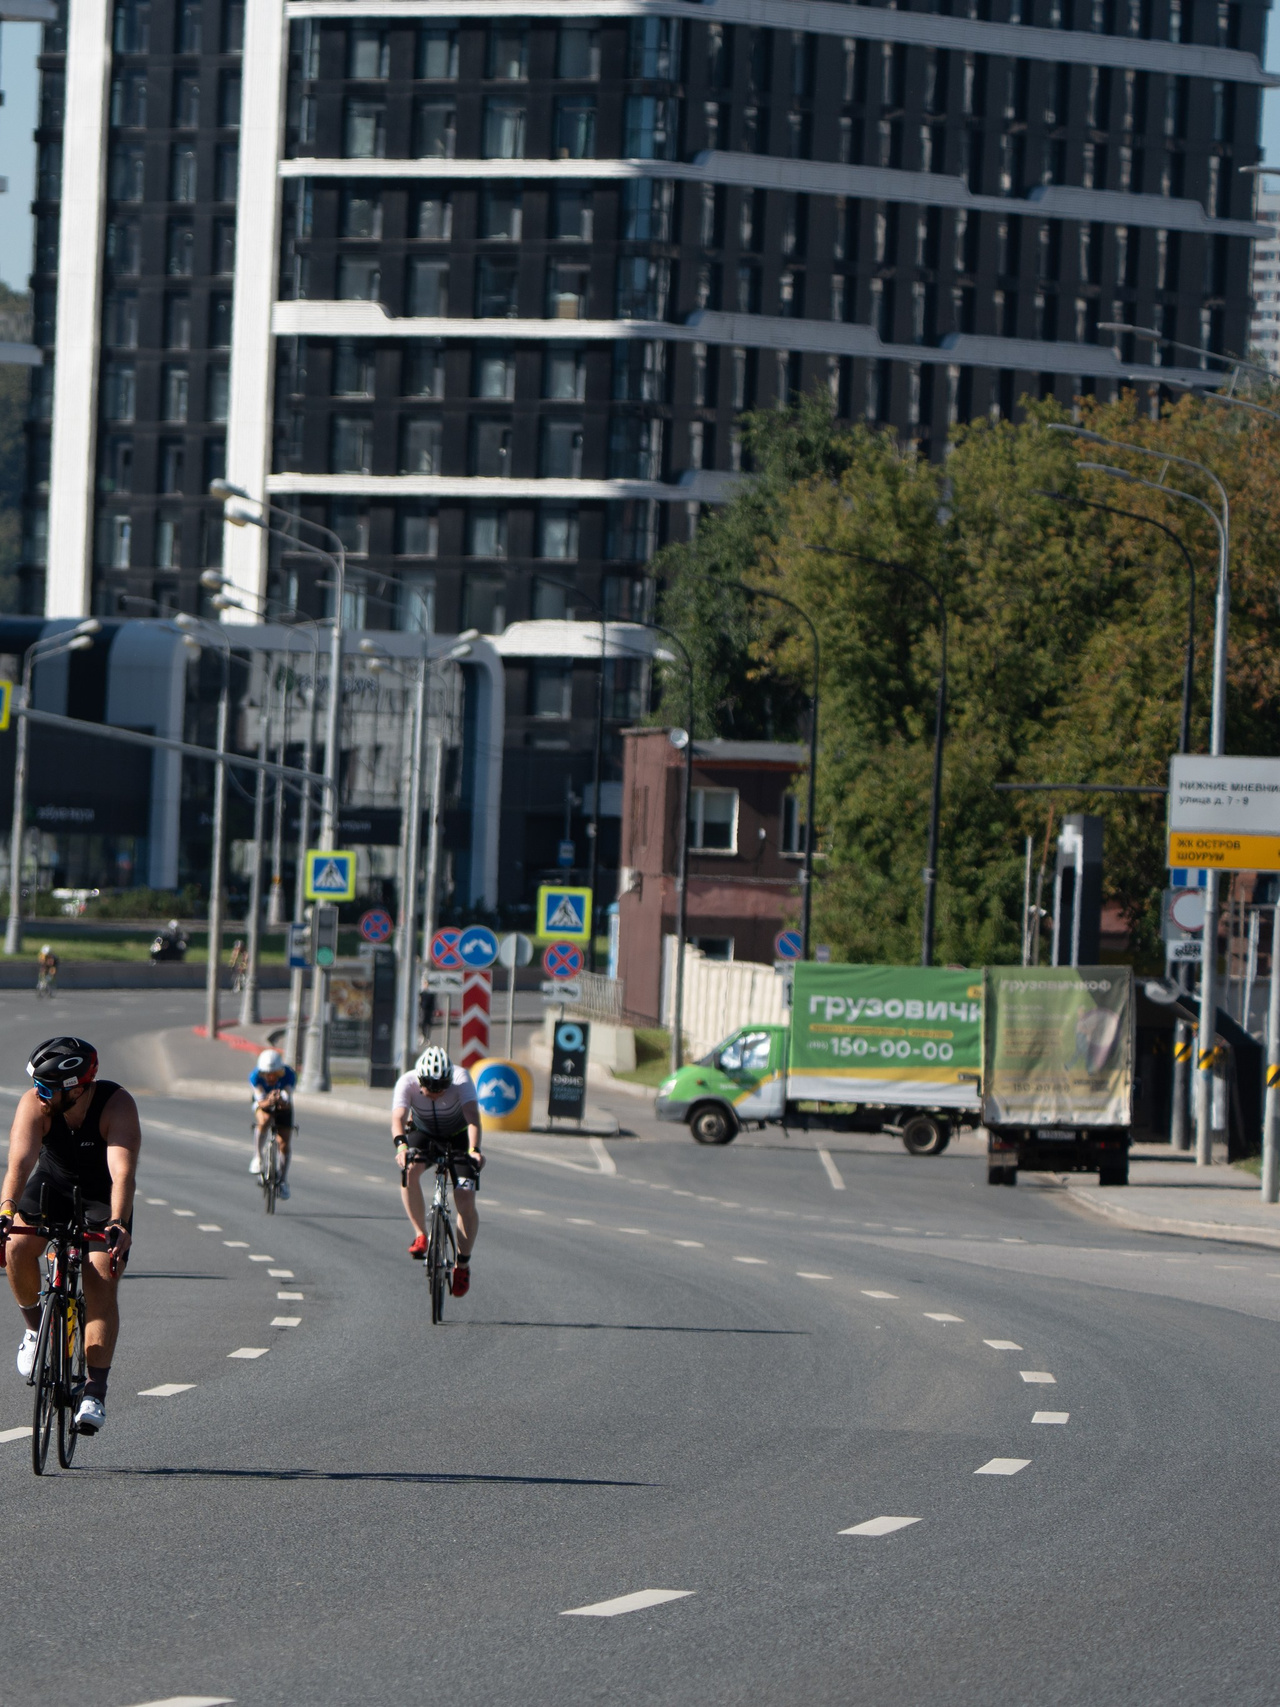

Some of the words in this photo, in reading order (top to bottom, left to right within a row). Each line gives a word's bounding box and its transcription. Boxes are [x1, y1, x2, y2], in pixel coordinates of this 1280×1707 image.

[1179, 781, 1228, 792] НИЖНИЕ
[1230, 782, 1280, 793] МНЕВНИ
[1177, 839, 1194, 848] ЖК
[1196, 839, 1241, 850] ОСТРОВ
[1177, 852, 1225, 861] ШОУРУМ
[831, 1036, 954, 1062] 150-00-00
